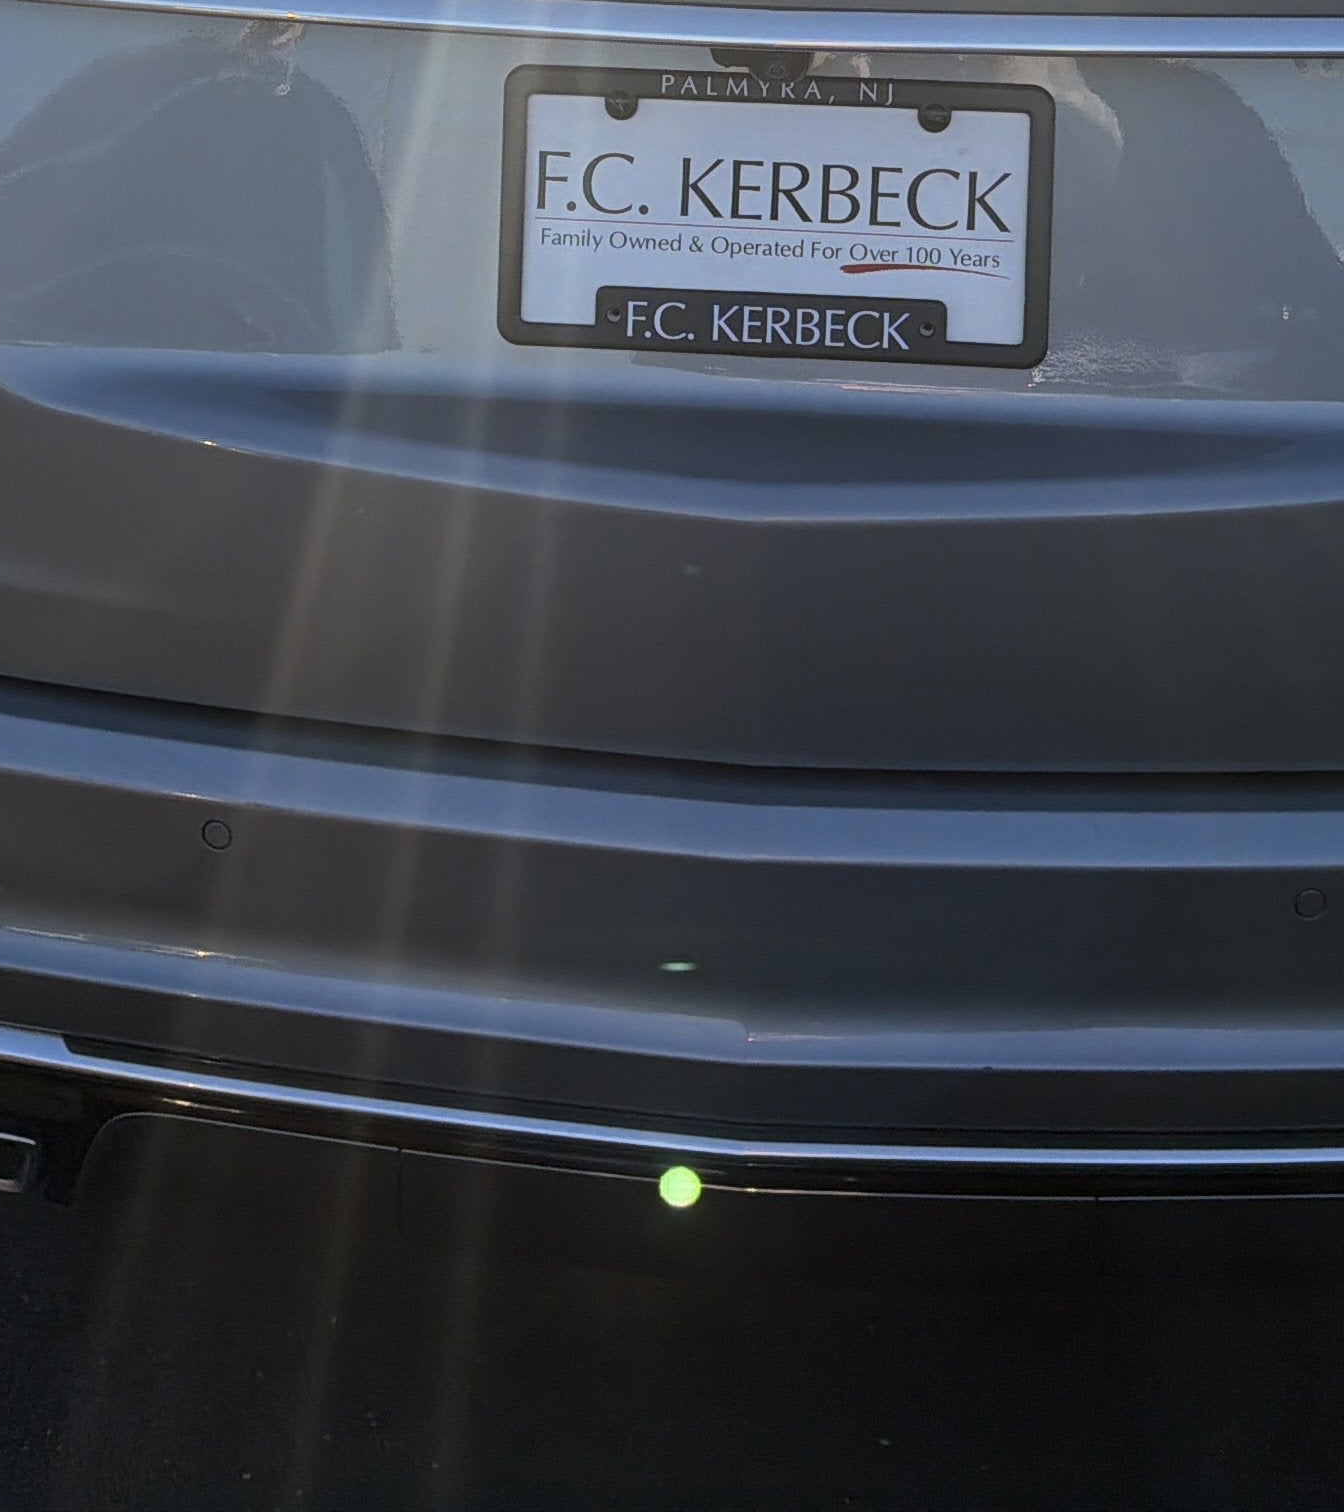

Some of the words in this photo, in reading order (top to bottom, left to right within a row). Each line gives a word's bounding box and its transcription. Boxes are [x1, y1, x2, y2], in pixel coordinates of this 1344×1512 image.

[859, 82, 893, 106] NJ
[536, 150, 649, 215] F.C.
[679, 157, 1012, 234] KERBECK
[540, 227, 603, 252] Family
[609, 231, 682, 252] Owned
[688, 235, 704, 253] &
[711, 233, 804, 258] Operated
[811, 241, 842, 260] For
[849, 243, 899, 263] Over
[906, 246, 942, 265] 100
[949, 248, 1000, 268] Years
[625, 300, 695, 341] F.C.
[711, 304, 911, 350] KERBECK
